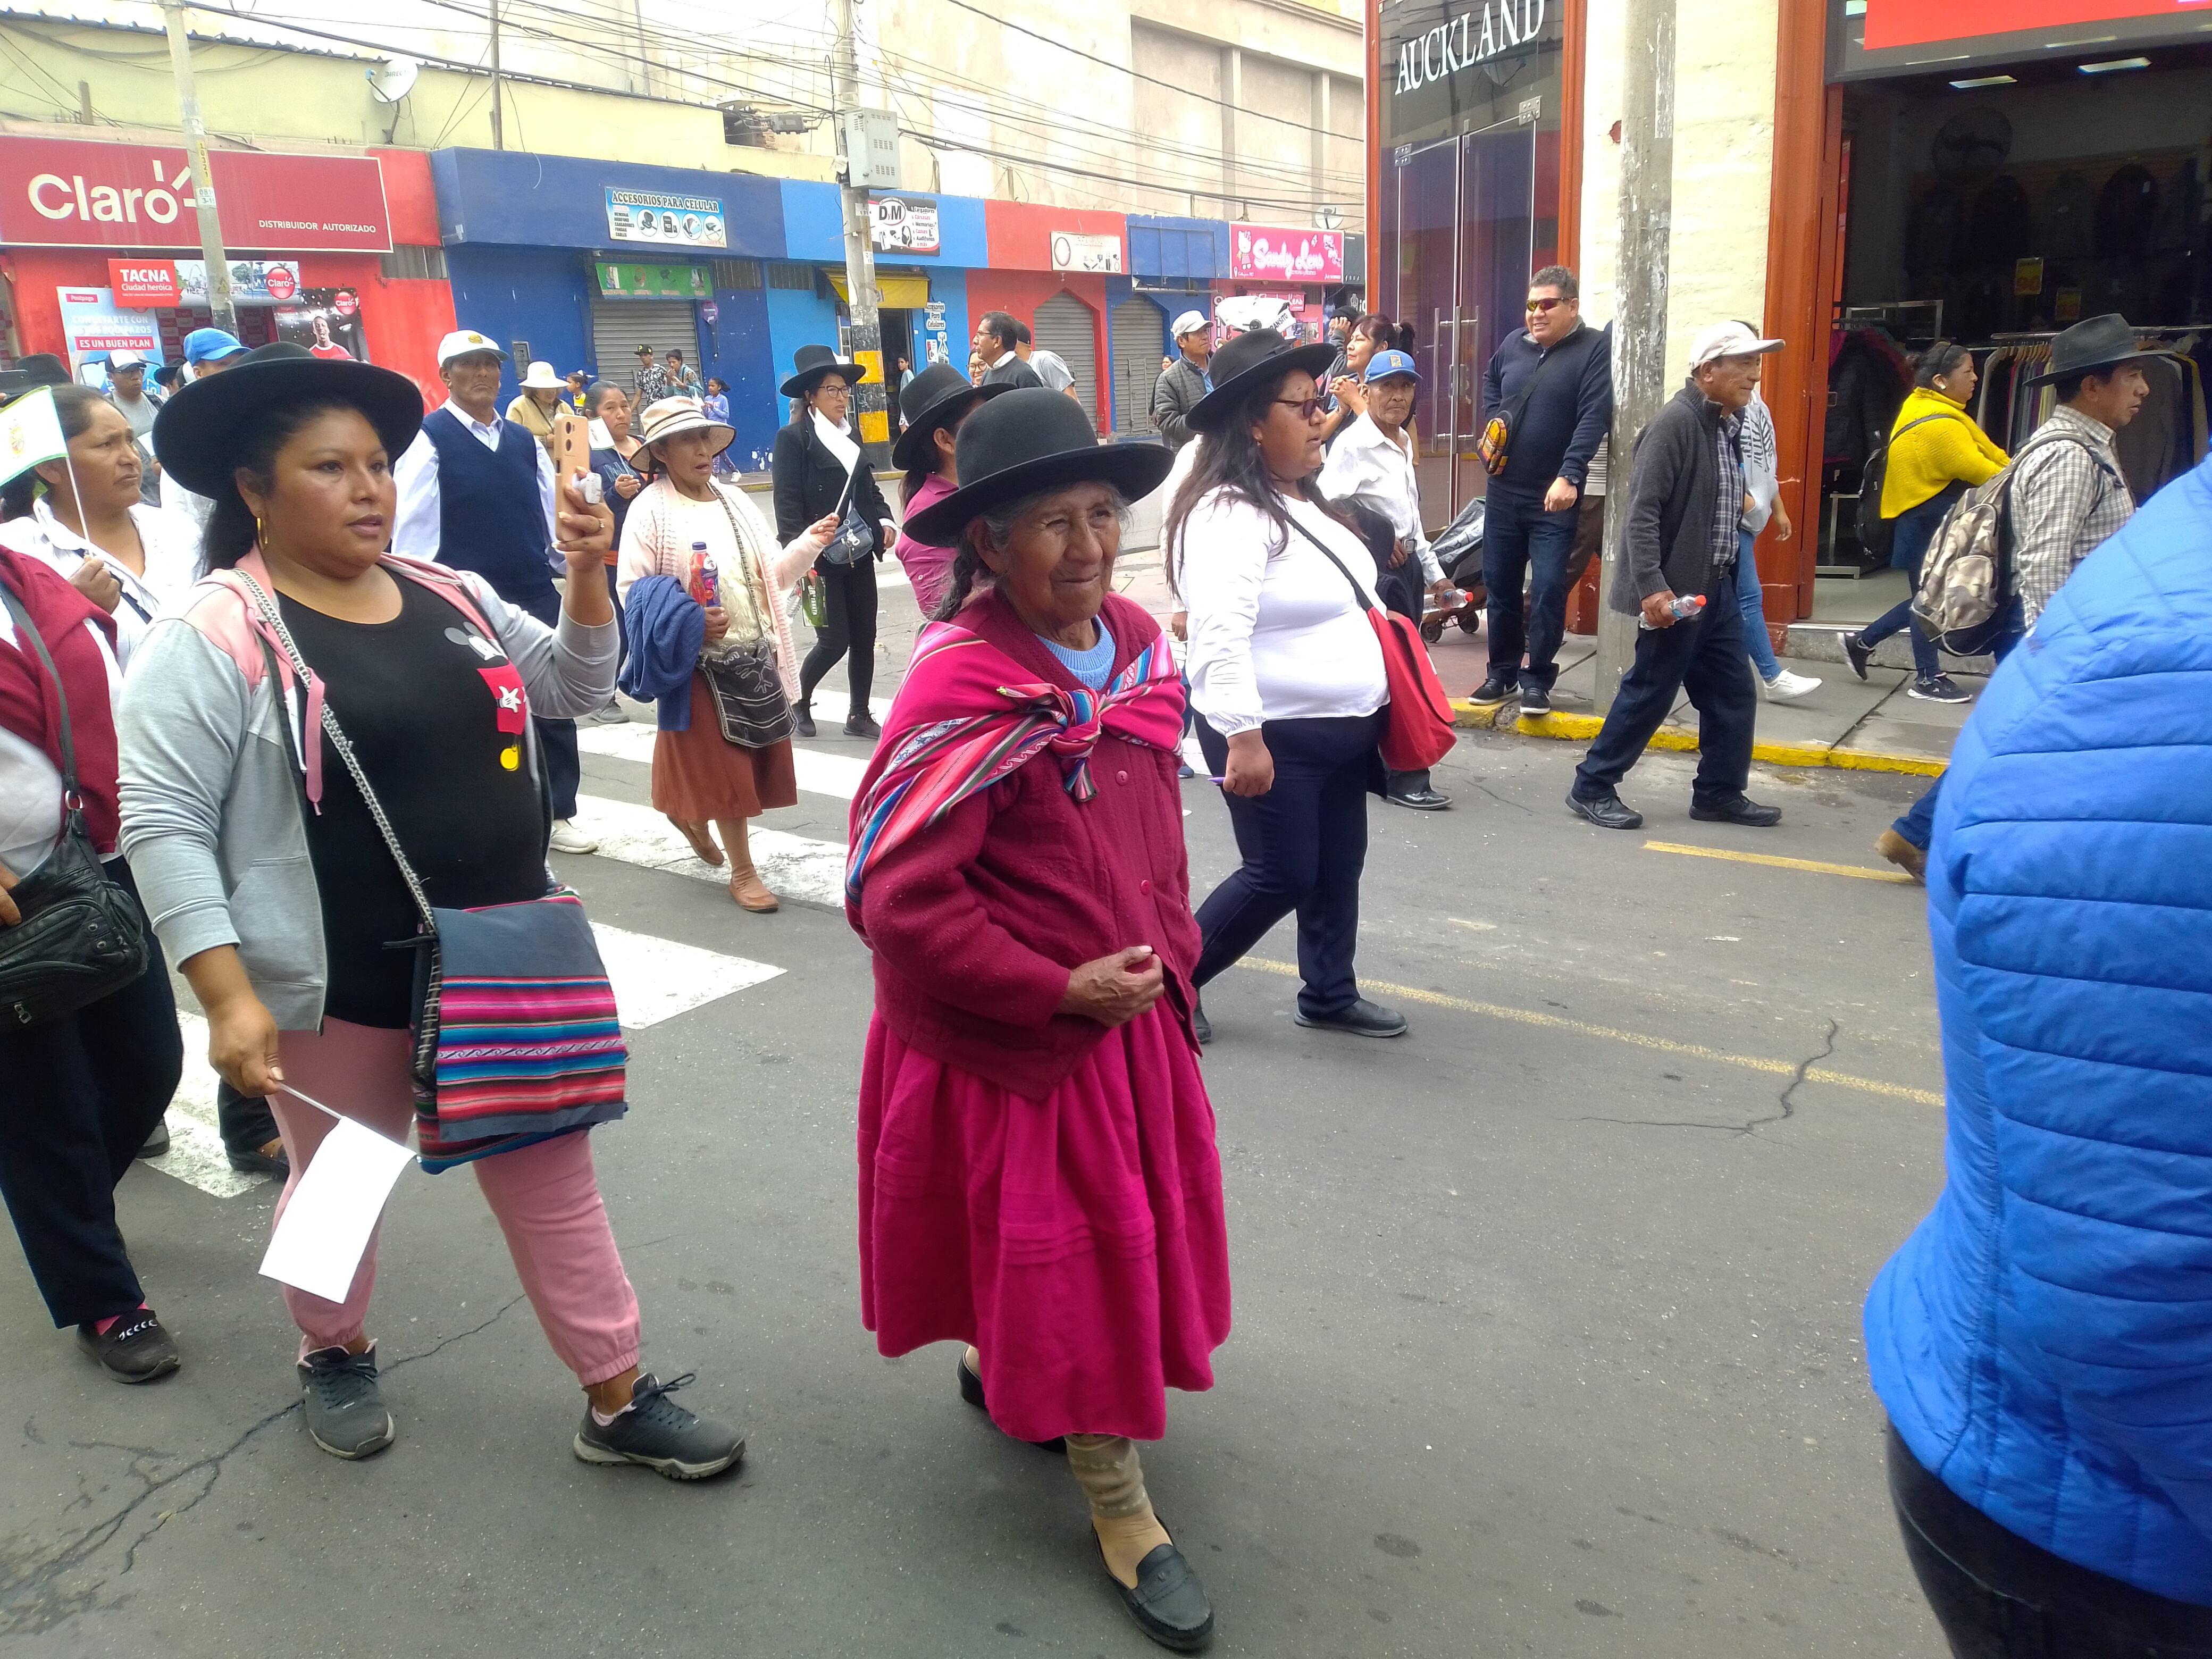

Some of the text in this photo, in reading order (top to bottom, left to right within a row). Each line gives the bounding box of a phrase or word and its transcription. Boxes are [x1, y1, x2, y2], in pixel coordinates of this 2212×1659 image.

[1395, 0, 1545, 95] AUCKLAND
[28, 173, 178, 224] Claro
[613, 191, 718, 212] ACCESORIOS PARA CELULAR
[879, 205, 902, 221] DyM
[258, 220, 376, 233] DISTRIBUIDOR AUTORIZADO
[1253, 238, 1324, 280] Sandy Lens
[119, 269, 170, 282] TACNA
[267, 279, 290, 287] Claro
[1269, 313, 1288, 329] RANSITO
[79, 339, 150, 348] ES UN BUEN PLAN
